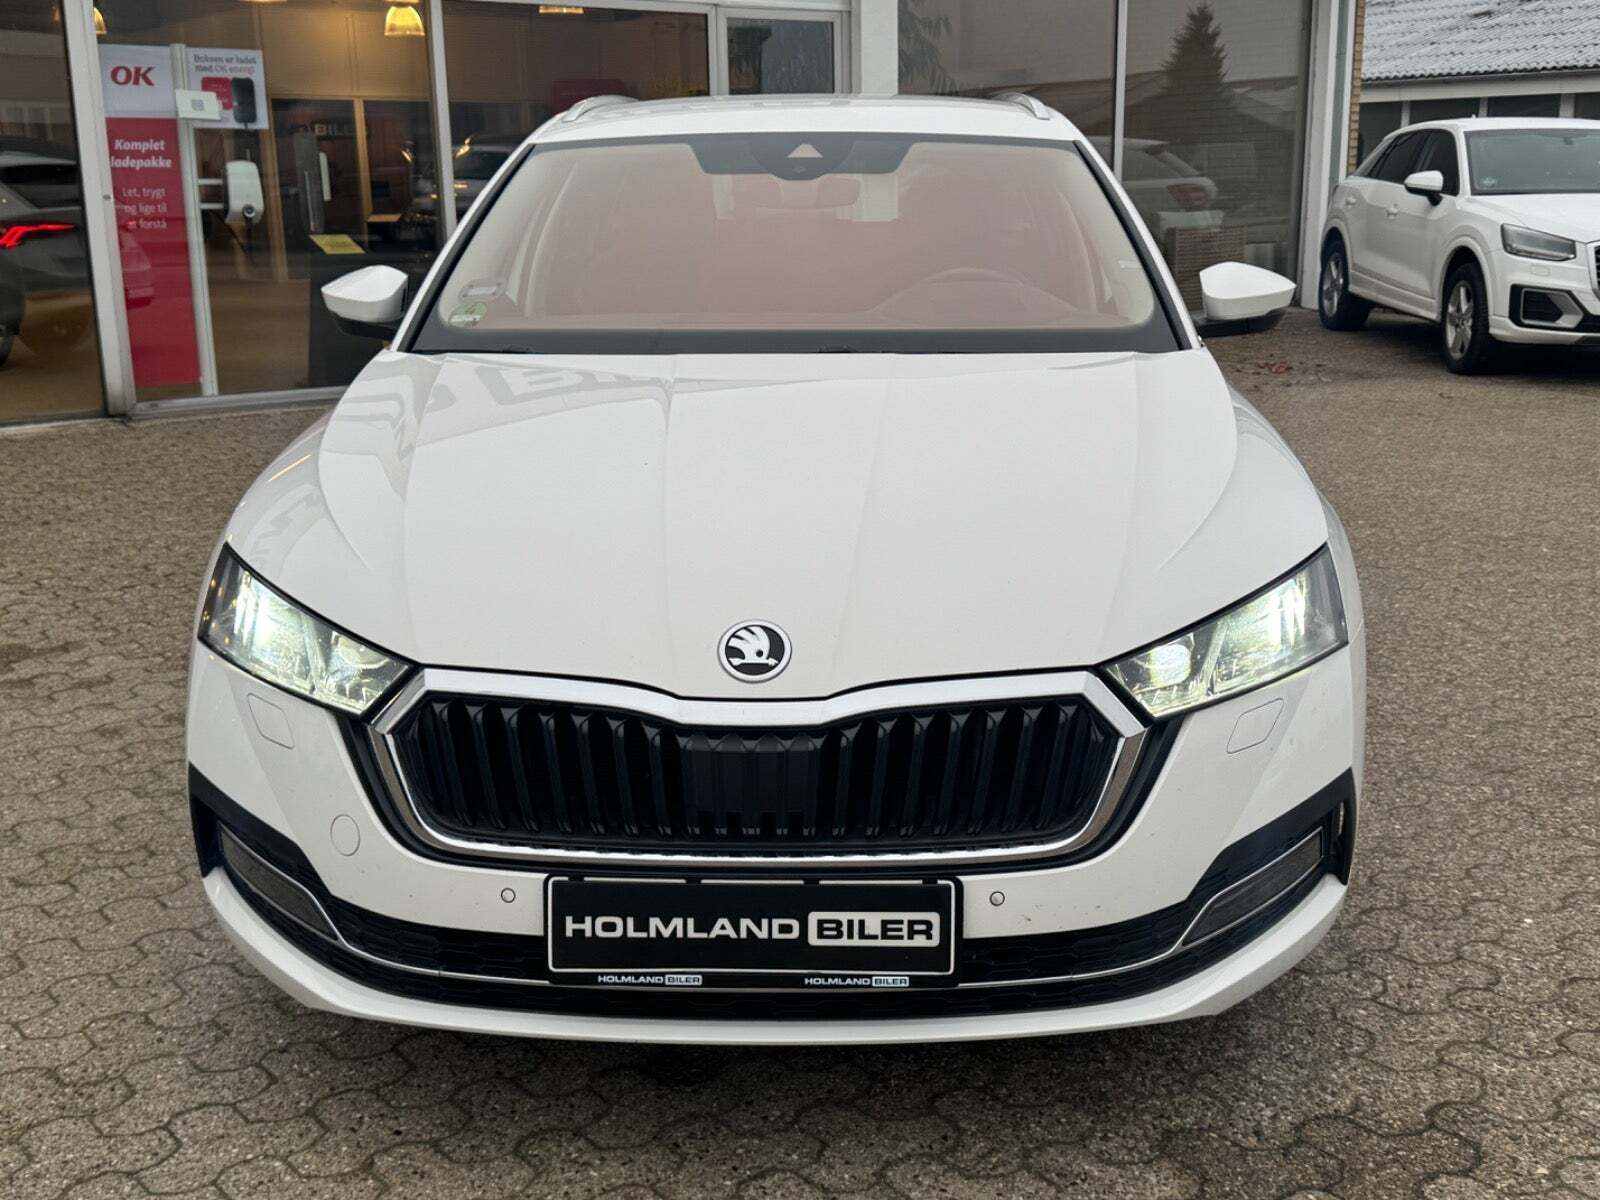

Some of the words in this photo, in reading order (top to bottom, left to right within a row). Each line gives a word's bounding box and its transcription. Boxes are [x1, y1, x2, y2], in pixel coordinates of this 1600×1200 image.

[110, 65, 156, 87] OK
[114, 139, 166, 154] Komplet
[110, 155, 172, 171] ladepakke
[142, 187, 166, 200] trygt
[138, 202, 156, 216] lige
[157, 201, 168, 213] til
[138, 216, 168, 230] forstå
[565, 915, 800, 940] HOLMLAND
[816, 917, 933, 941] BILER
[597, 975, 664, 984] HOLMLAND
[668, 975, 700, 985] BILER
[804, 977, 870, 986] HOLMLAND
[874, 977, 906, 987] BILER
